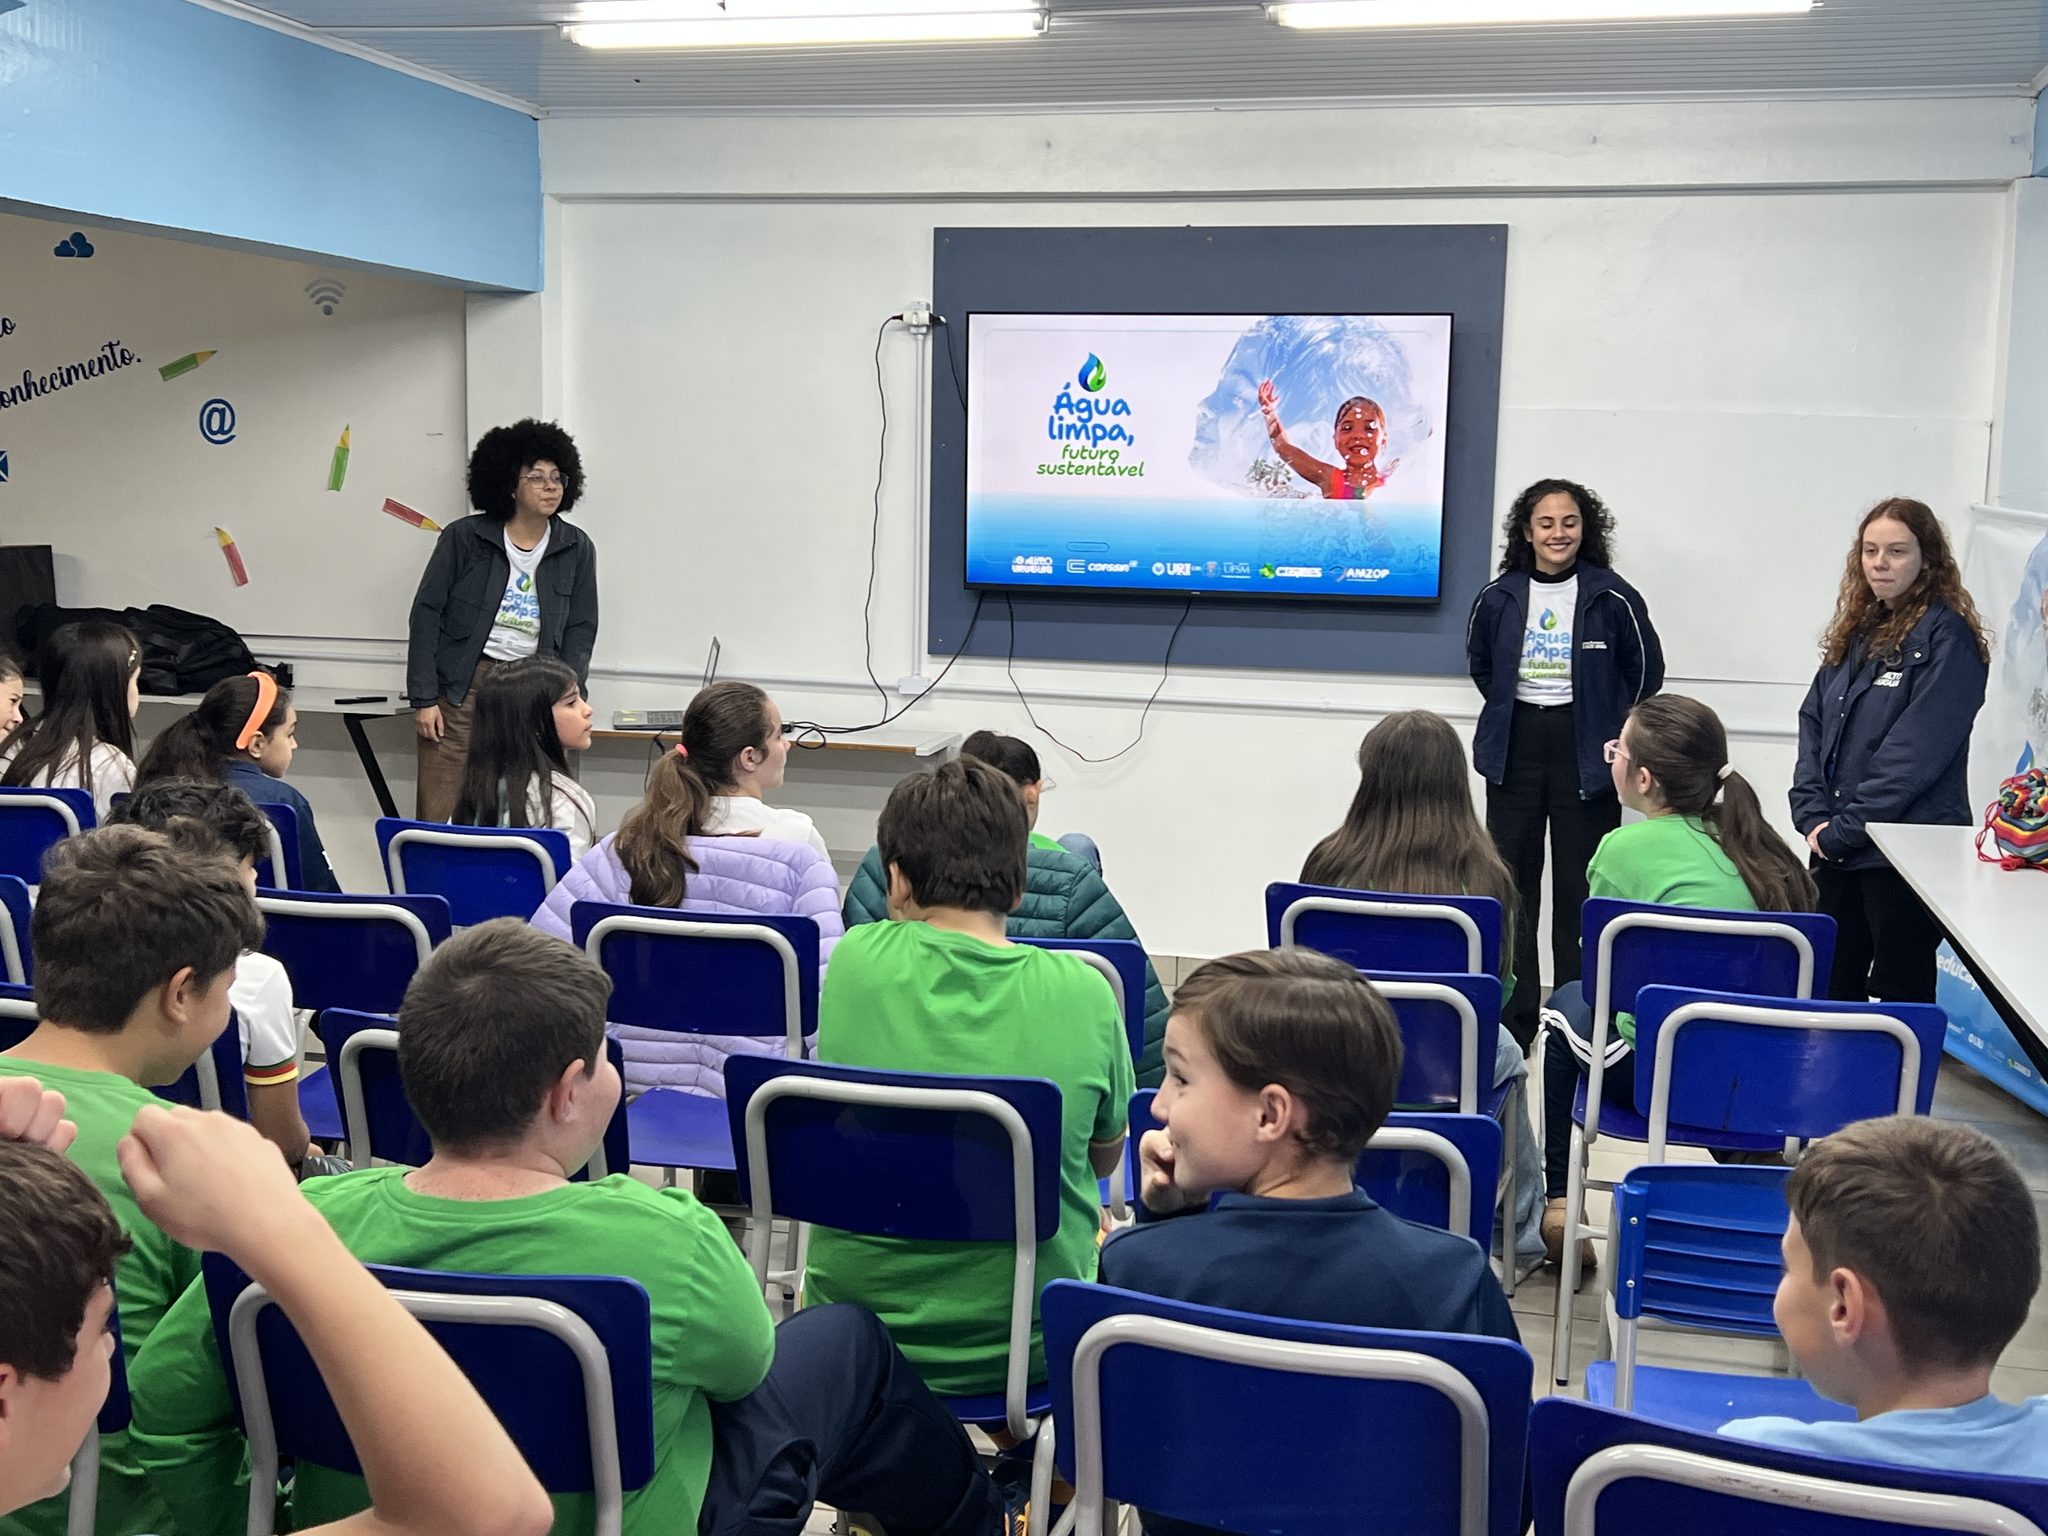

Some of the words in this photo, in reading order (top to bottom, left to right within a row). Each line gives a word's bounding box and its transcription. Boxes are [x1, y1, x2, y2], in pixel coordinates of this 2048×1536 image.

[0, 339, 142, 411] onhecimento.
[1053, 381, 1132, 424] Água
[1048, 415, 1135, 449] limpa,
[1062, 444, 1120, 461] futuro
[1036, 460, 1145, 477] sustentável
[1167, 563, 1192, 576] URI
[1223, 564, 1250, 573] UFSM
[1528, 659, 1567, 671] futuro
